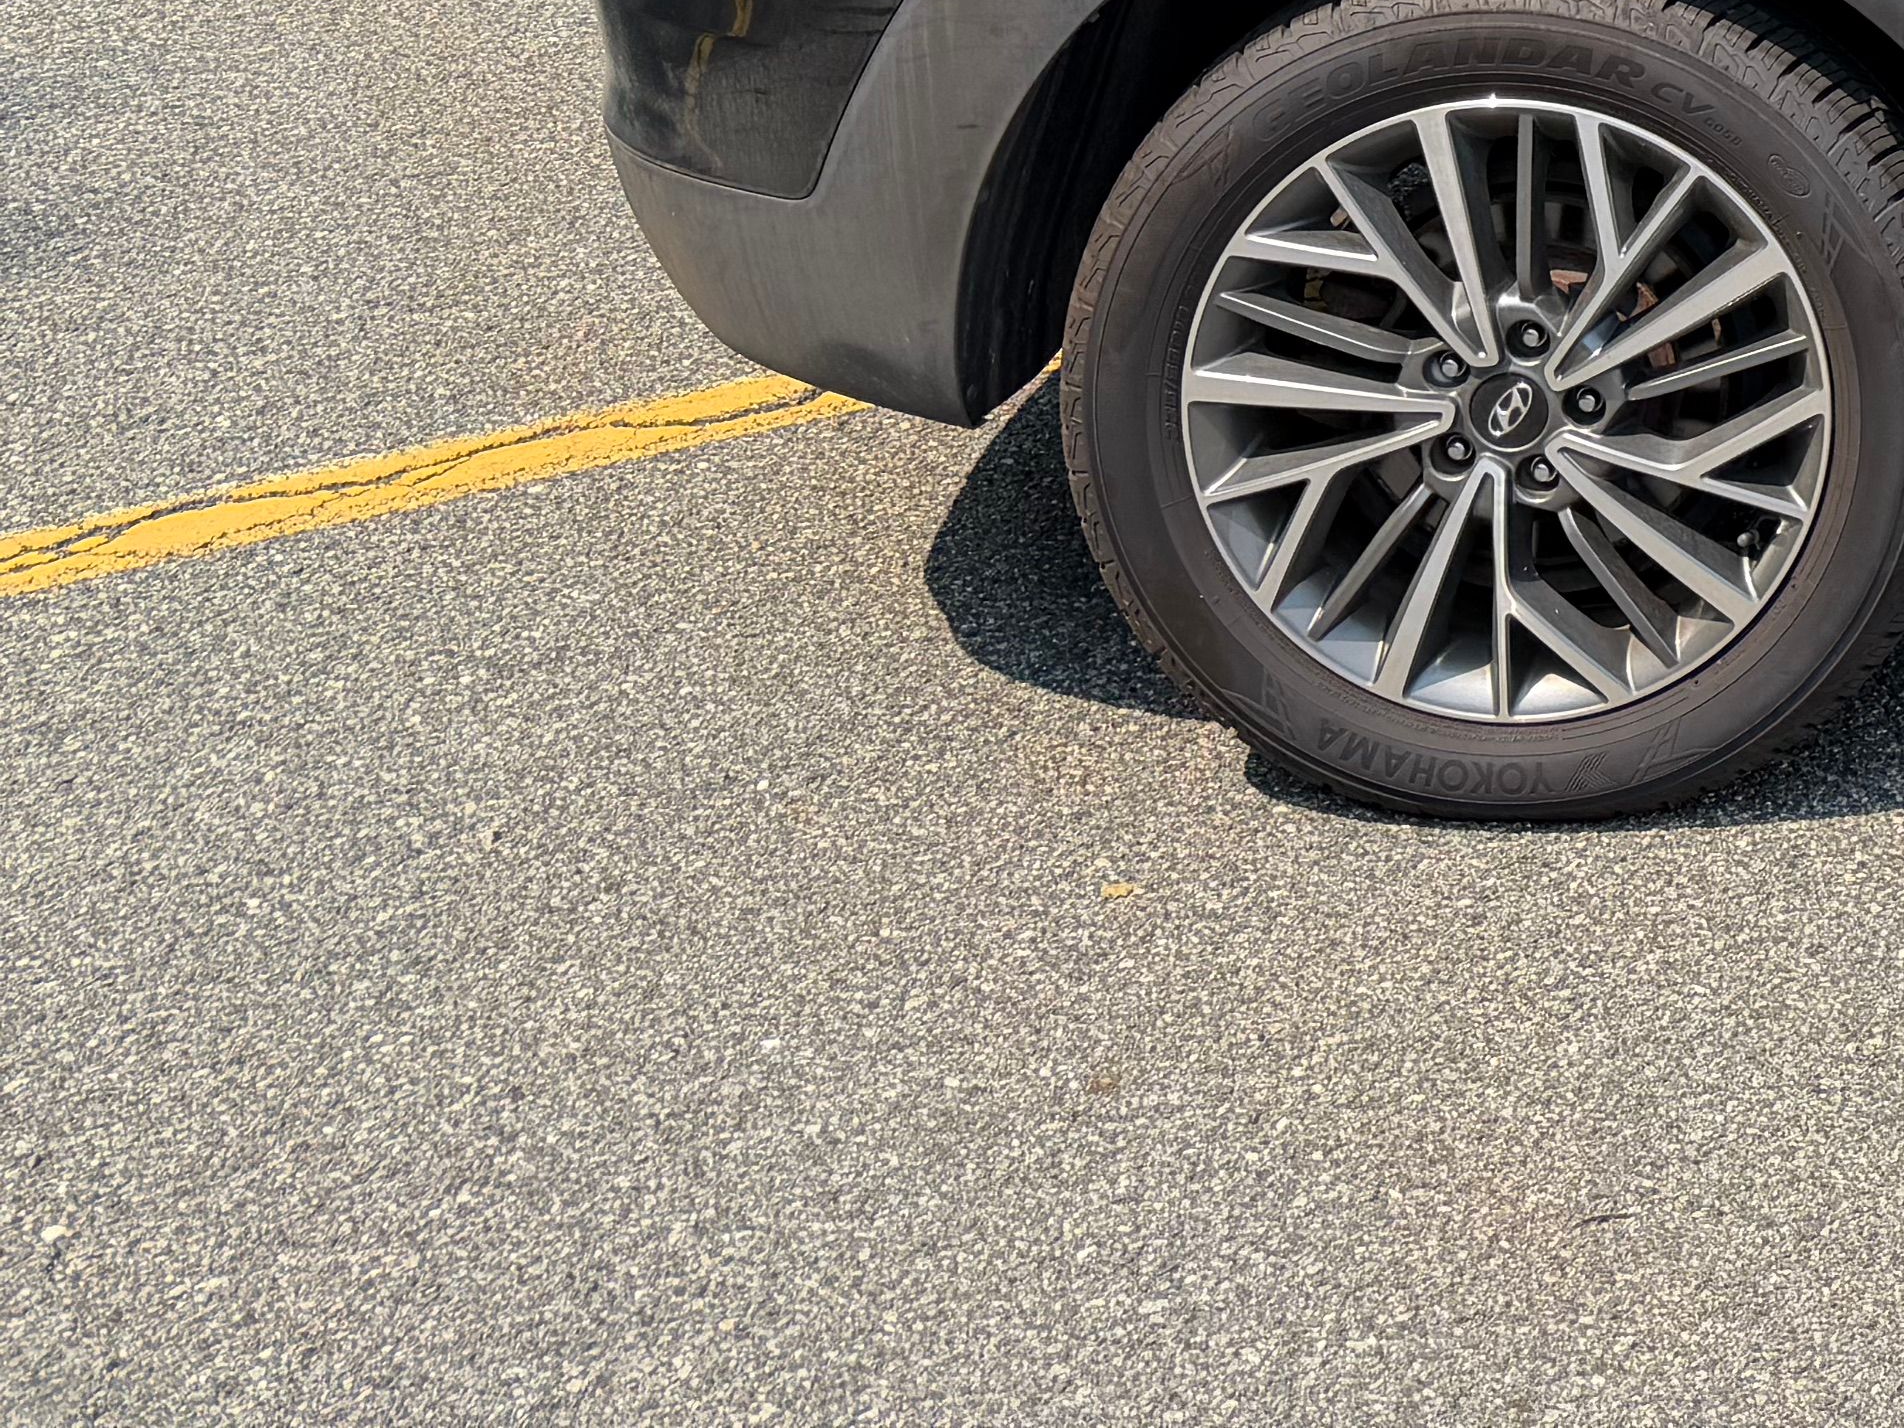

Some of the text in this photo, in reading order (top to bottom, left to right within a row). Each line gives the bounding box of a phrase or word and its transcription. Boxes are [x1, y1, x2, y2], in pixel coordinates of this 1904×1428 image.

[1250, 33, 1647, 137] GEOLANDAR
[1650, 82, 1715, 117] CV
[1316, 717, 1557, 795] YOKOHAMA
